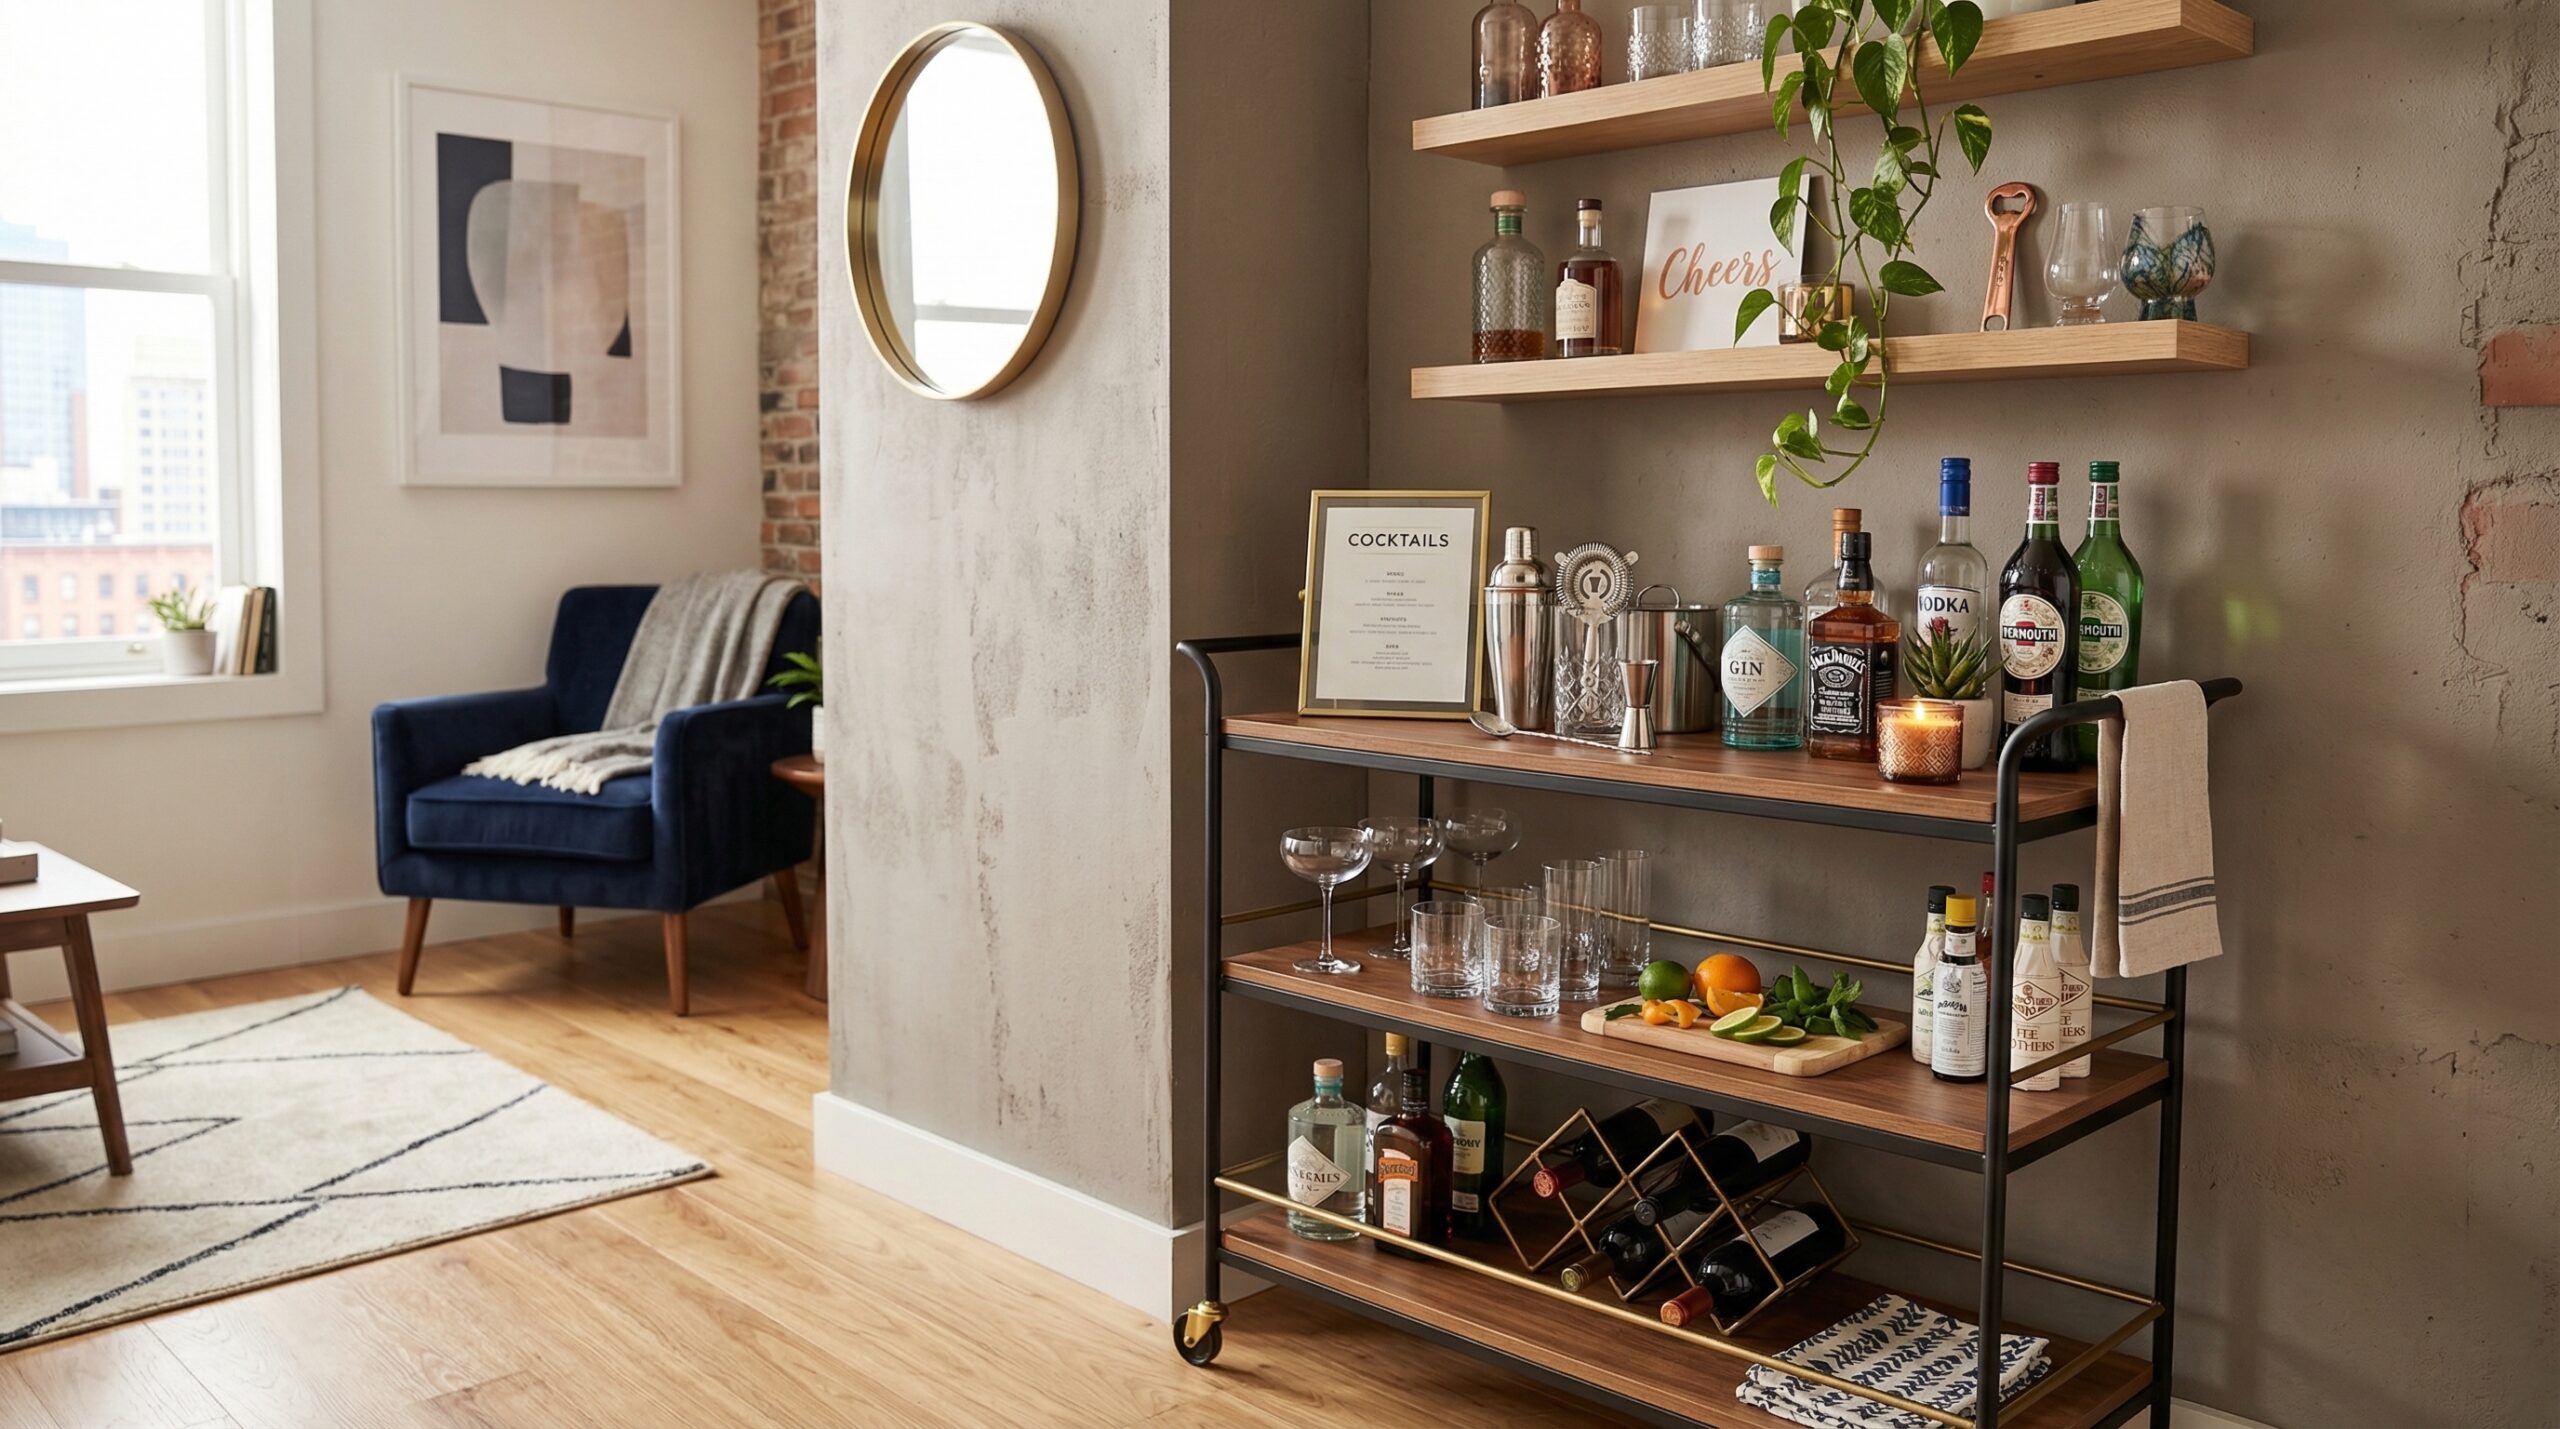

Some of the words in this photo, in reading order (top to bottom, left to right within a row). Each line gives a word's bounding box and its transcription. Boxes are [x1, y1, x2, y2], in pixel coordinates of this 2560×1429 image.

[1658, 242, 1782, 299] Cheers
[1348, 533, 1449, 547] COCKTAILS
[1729, 660, 1764, 676] GIN
[2017, 1028, 2038, 1040] FEE
[2011, 1039, 2055, 1051] OTHERS
